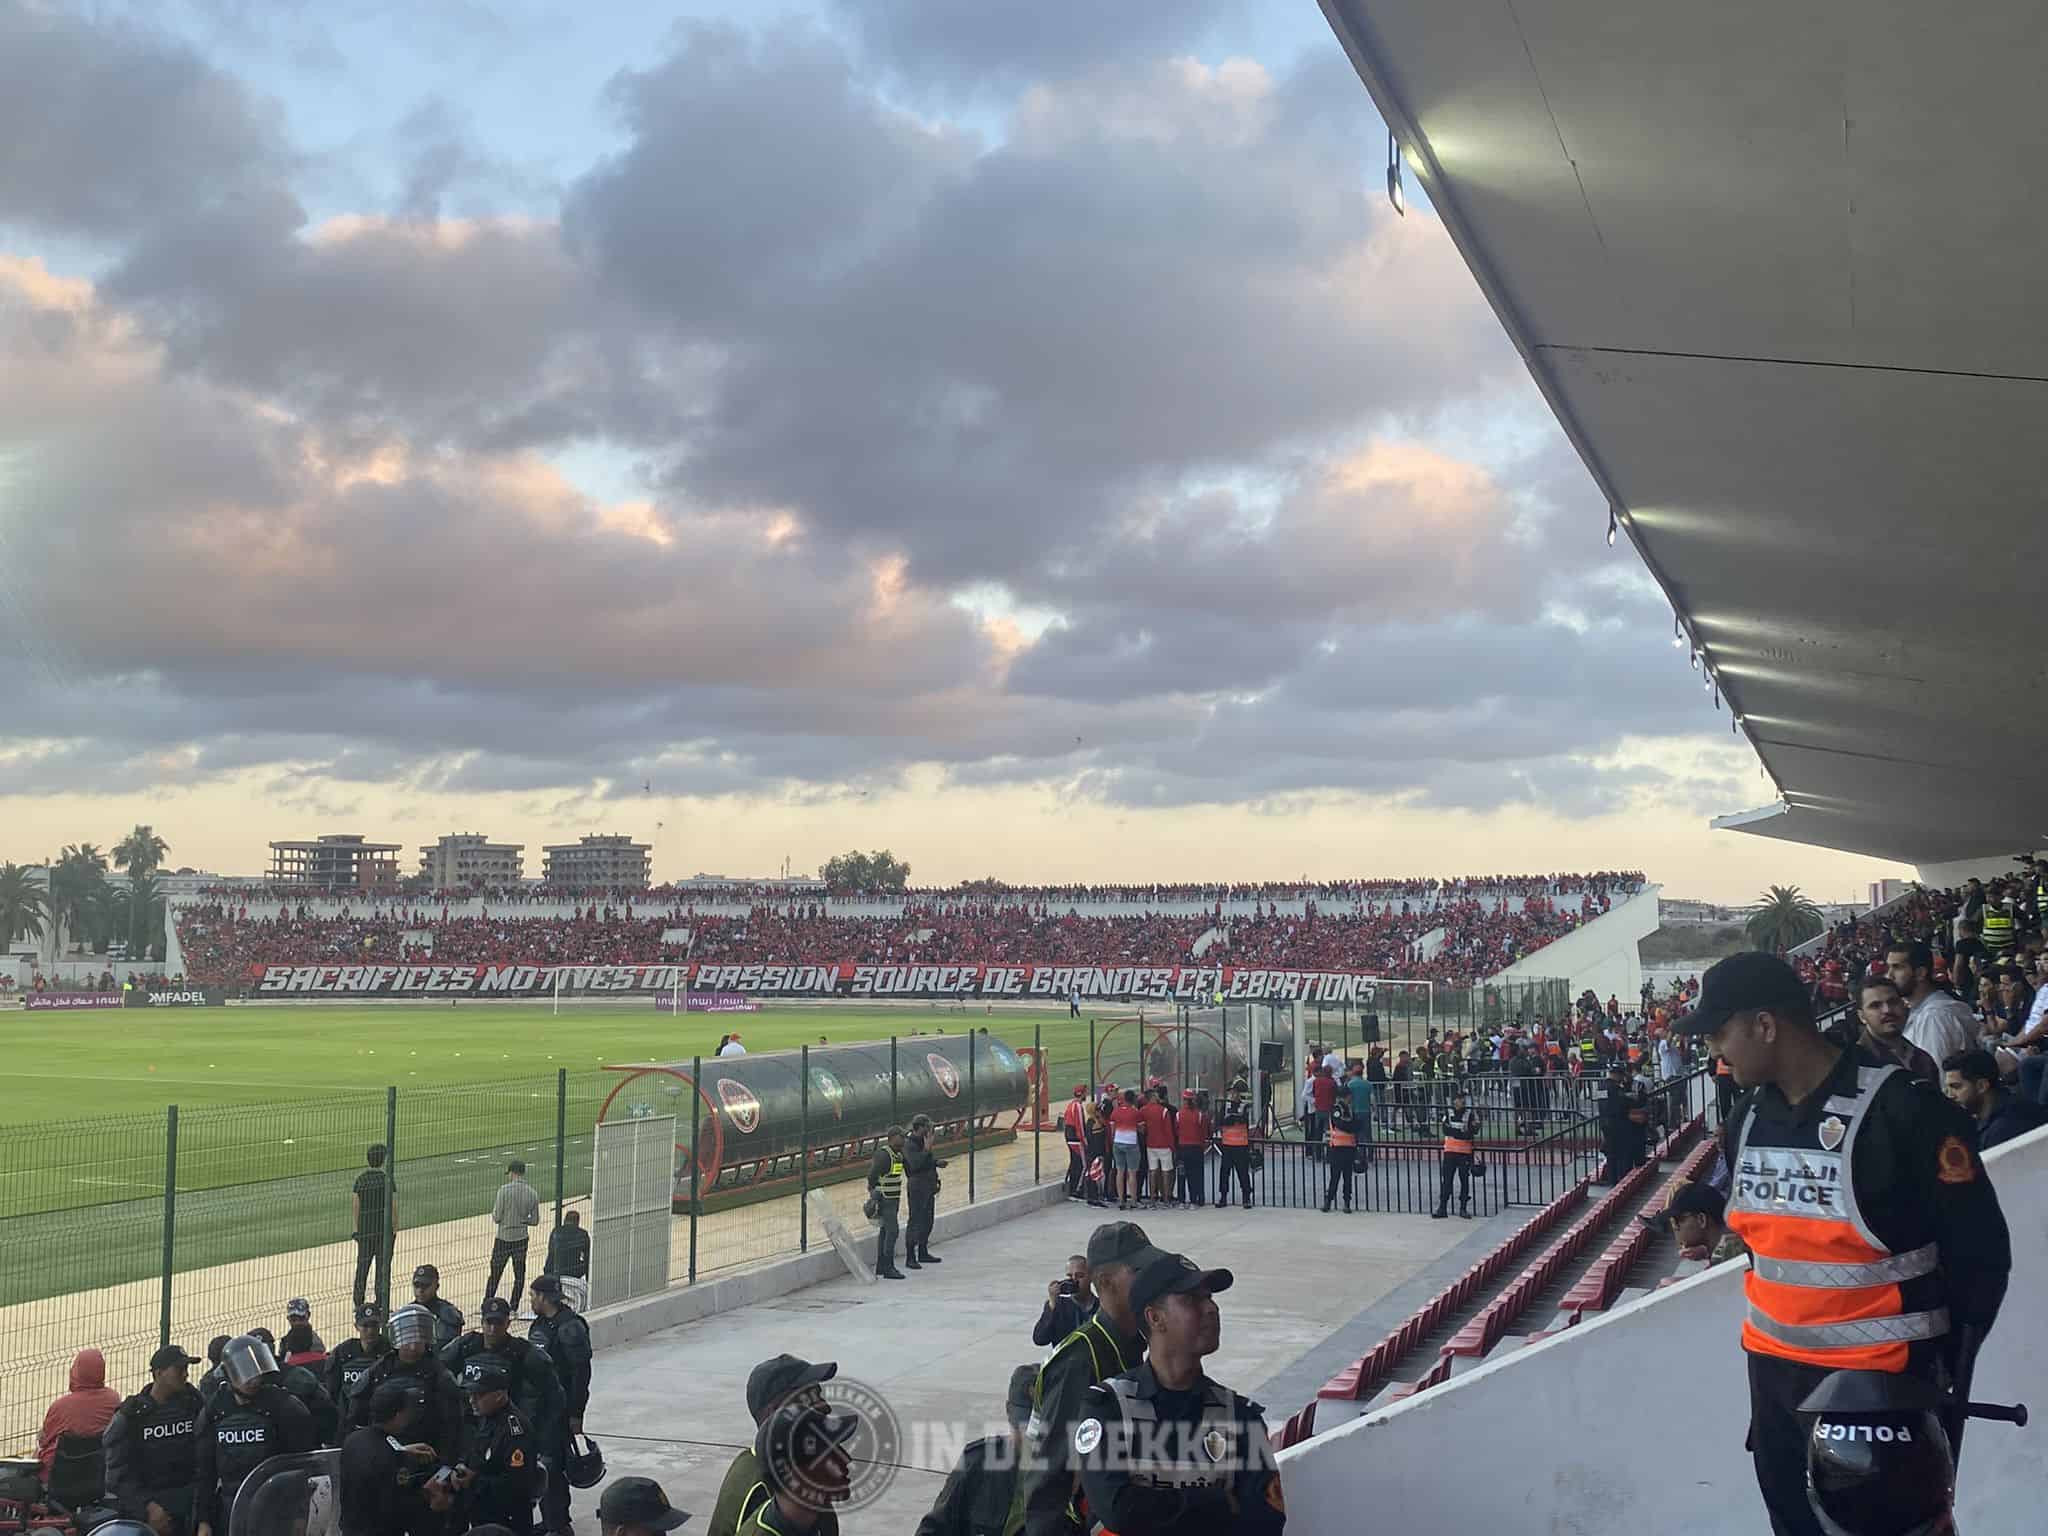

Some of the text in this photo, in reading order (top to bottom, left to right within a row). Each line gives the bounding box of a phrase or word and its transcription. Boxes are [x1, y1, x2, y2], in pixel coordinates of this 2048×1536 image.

[260, 966, 477, 991] SACRIFICES
[480, 966, 637, 990] MOTIVES
[852, 966, 977, 993] SOURCE
[982, 967, 1026, 994] DE
[1029, 967, 1173, 995] GRANDES
[1176, 968, 1377, 1003] CELEBRATIONS
[1738, 1179, 1834, 1206] POLICE
[143, 1420, 193, 1441] POLICE
[217, 1429, 265, 1443] POLICE
[1816, 1423, 1913, 1442] POLICE
